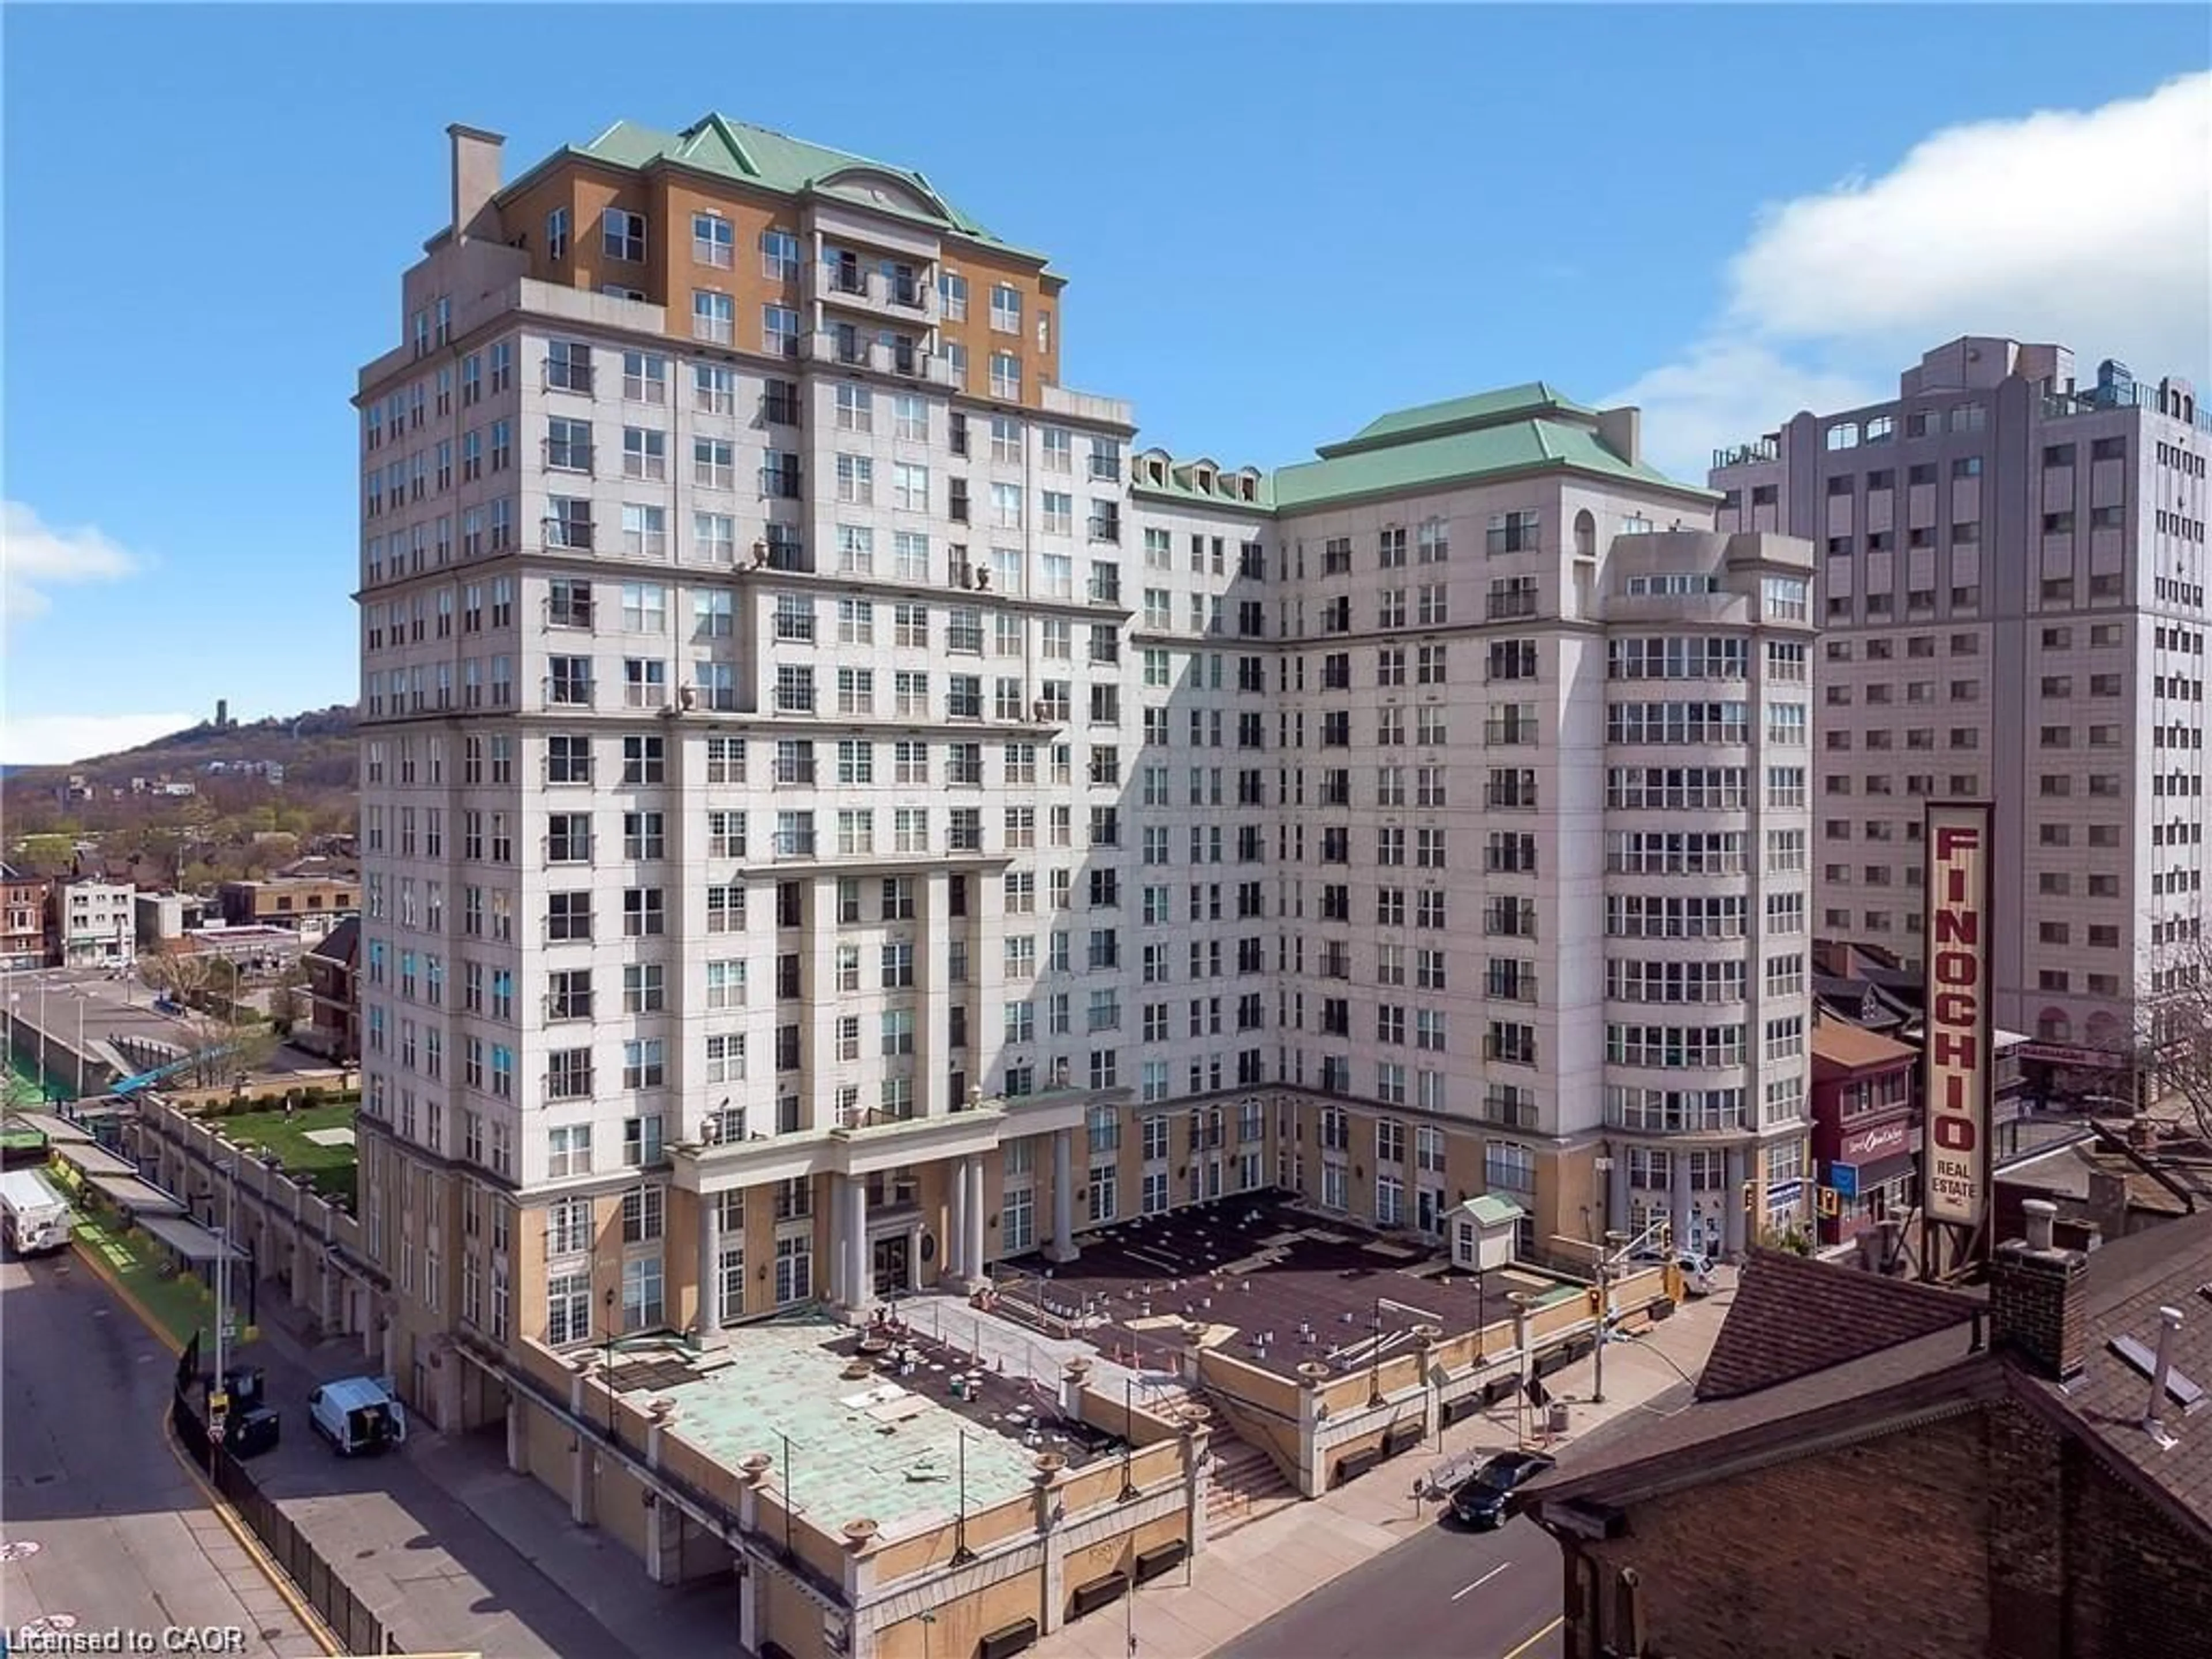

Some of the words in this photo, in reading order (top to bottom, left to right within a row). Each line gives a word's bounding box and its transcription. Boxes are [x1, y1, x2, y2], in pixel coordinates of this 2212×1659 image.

[1934, 828, 1978, 1152] FINOCHIO
[1937, 1160, 1970, 1178] REAL
[1932, 1177, 1978, 1198] ESTATE
